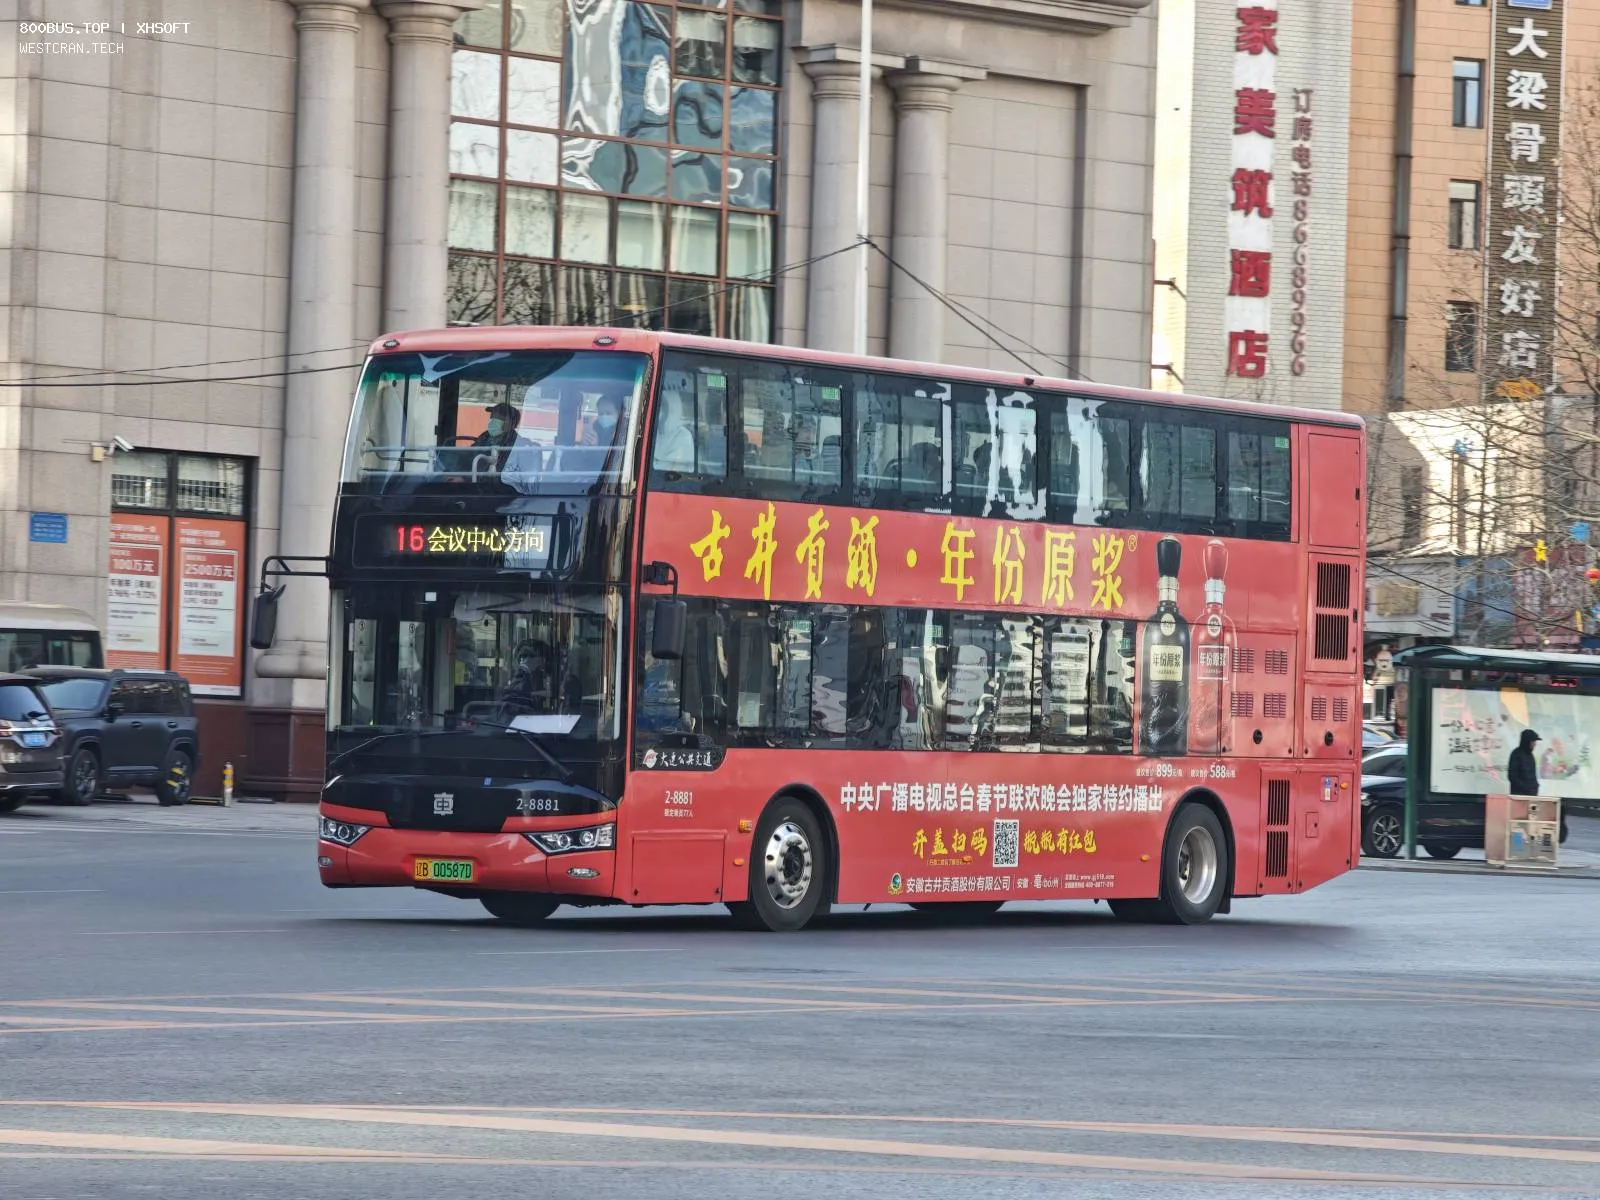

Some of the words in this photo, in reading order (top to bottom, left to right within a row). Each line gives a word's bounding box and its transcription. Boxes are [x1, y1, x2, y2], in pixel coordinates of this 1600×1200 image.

[1227, 6, 1279, 378] 家美筑酒店
[397, 524, 425, 552] 16
[427, 526, 545, 552] 会议中心方向
[516, 798, 560, 811] 2-8881
[665, 790, 693, 805] 2-8881
[840, 781, 1163, 813] 中央广播电视总台春节联欢晚会独家特约播出
[912, 827, 988, 860] 开盖扫码
[906, 876, 1011, 893] 安徽古井贡酒股份有限公司
